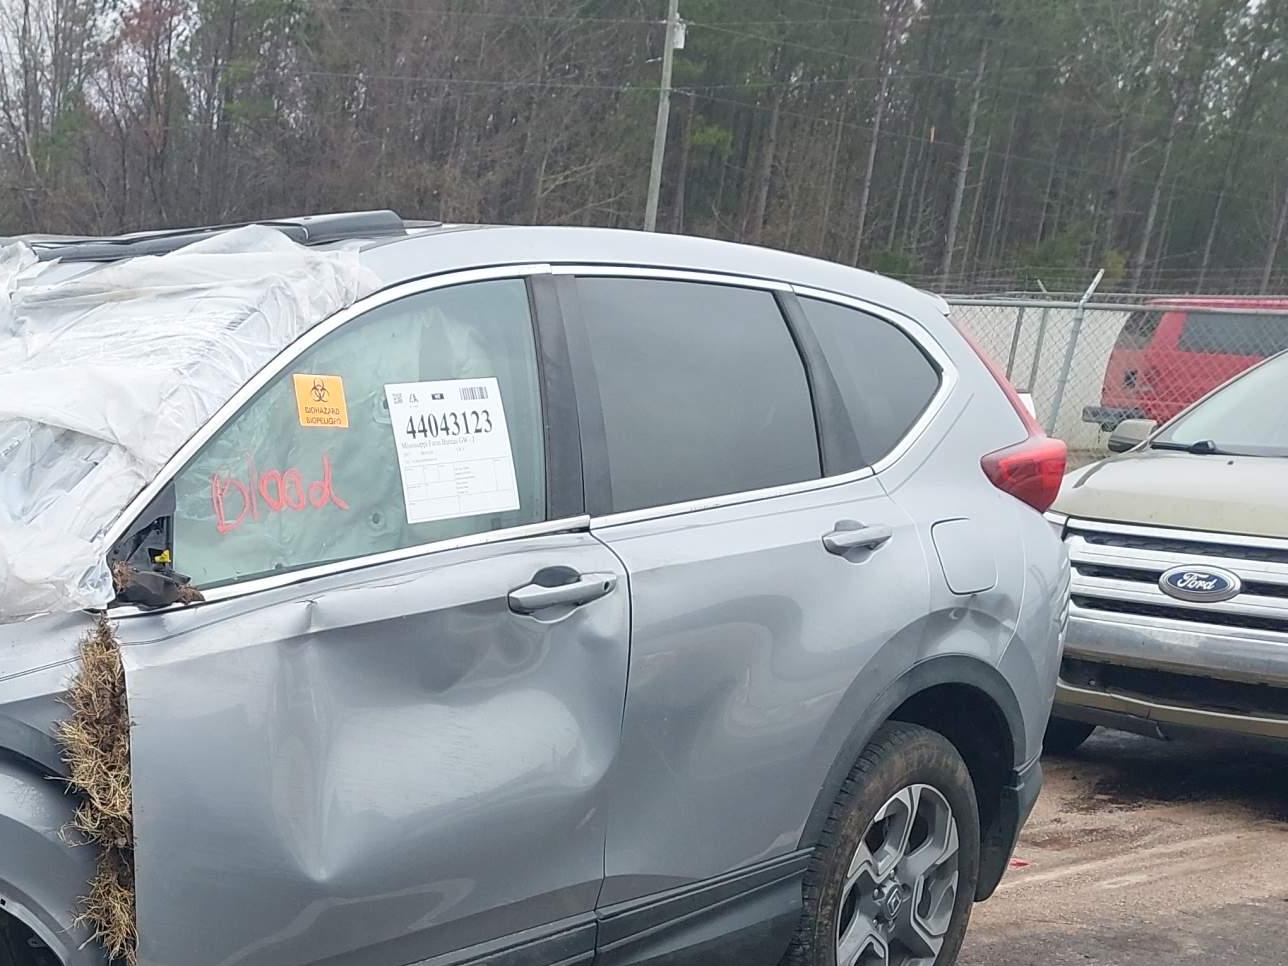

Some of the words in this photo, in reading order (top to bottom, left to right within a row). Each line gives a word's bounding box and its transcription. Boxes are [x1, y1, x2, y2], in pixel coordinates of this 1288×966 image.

[304, 406, 340, 415] BIOHAZARD
[406, 409, 493, 439] 44043123
[210, 452, 350, 535] Blood
[1177, 572, 1217, 590] Ford
